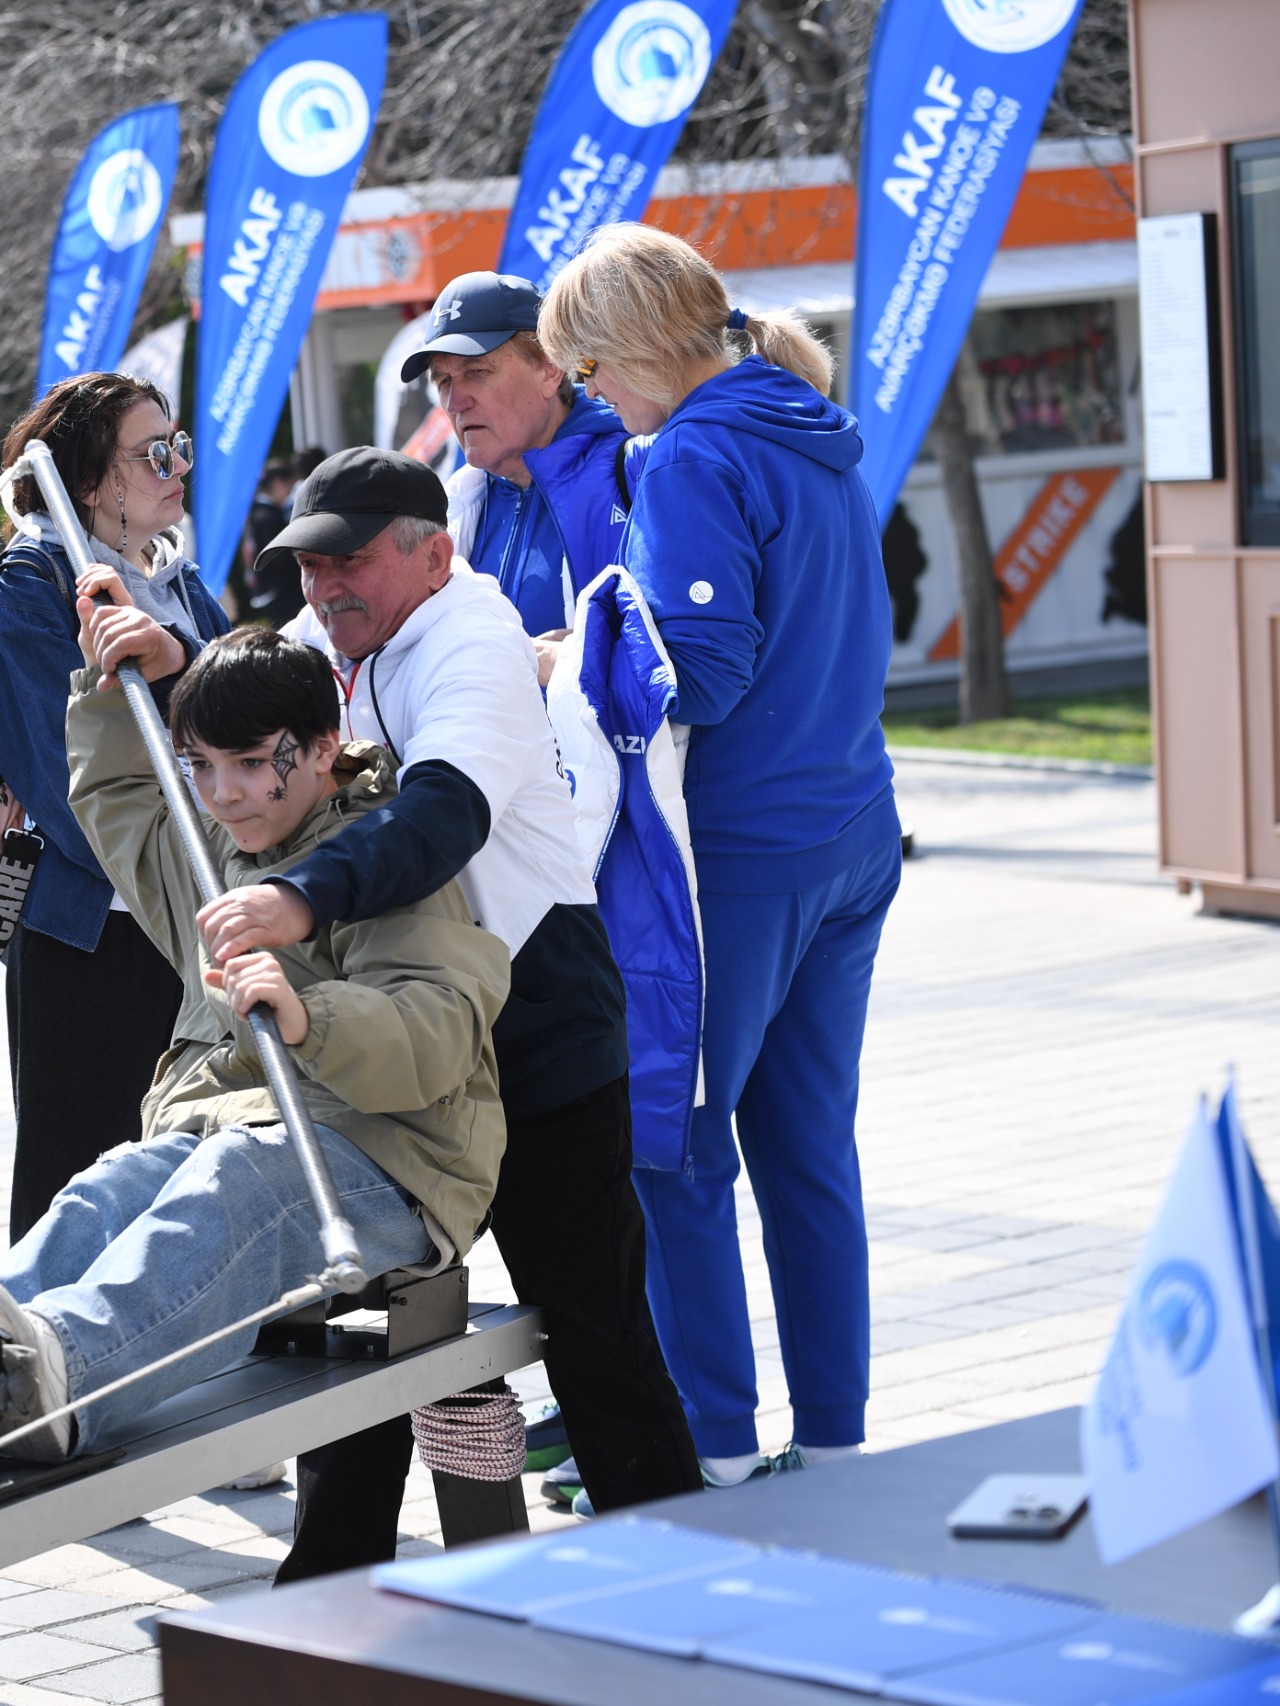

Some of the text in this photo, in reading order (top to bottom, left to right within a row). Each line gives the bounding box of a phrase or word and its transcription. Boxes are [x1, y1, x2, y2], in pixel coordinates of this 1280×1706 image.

[528, 134, 605, 262] AKAF
[882, 65, 963, 218] AKAF
[929, 124, 980, 208] KANOE
[964, 86, 997, 123] VƏ
[219, 187, 283, 306] AKAF
[54, 264, 103, 370] AKAF
[1001, 475, 1091, 595] STRIKE
